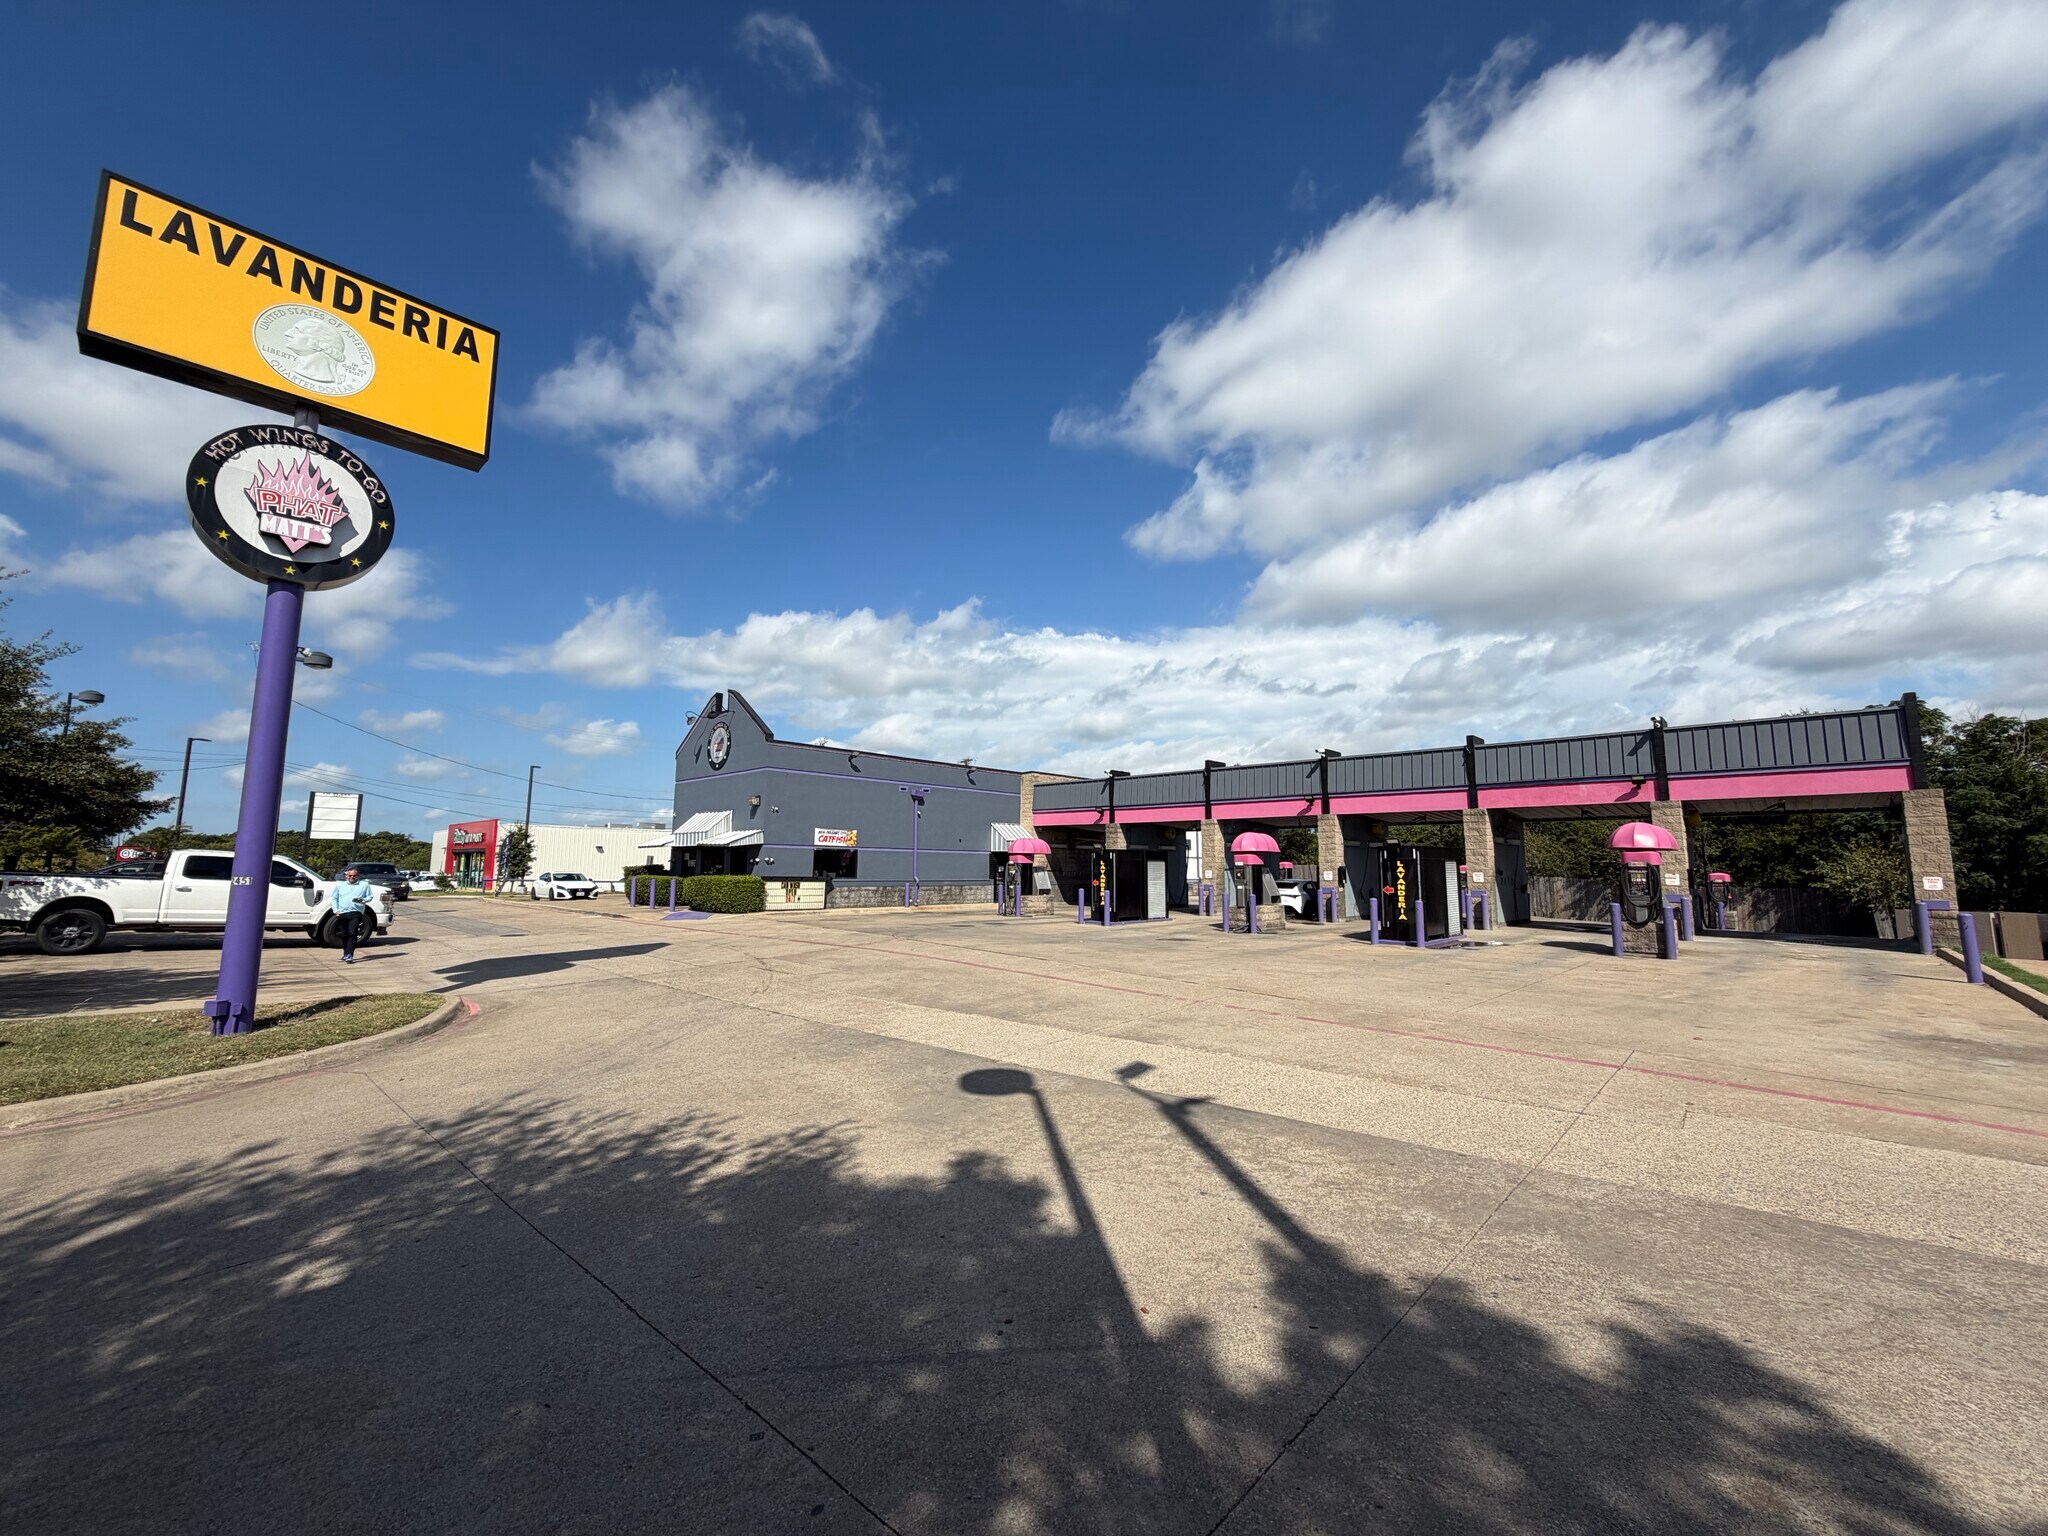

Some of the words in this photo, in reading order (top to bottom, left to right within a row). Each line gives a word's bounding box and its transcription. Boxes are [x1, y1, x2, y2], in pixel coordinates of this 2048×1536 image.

[119, 188, 480, 363] LAVANDERIA
[258, 309, 286, 331] UNITED
[287, 307, 325, 320] STATES
[328, 315, 343, 328] OF
[342, 329, 370, 366] AMERICA
[262, 345, 298, 361] LIBERTY
[271, 359, 315, 390] QUARTER
[318, 384, 355, 394] DOLLAR
[341, 363, 356, 371] GOD
[345, 368, 364, 377] TRUST
[204, 432, 244, 460] HOT
[248, 427, 330, 454] WINGS
[337, 450, 362, 472] TO
[363, 477, 386, 503] GO
[255, 487, 343, 528] PHAT
[260, 513, 333, 545] MATT'S
[818, 835, 848, 844] CATFISH
[1396, 860, 1407, 920] LAVANDERIA
